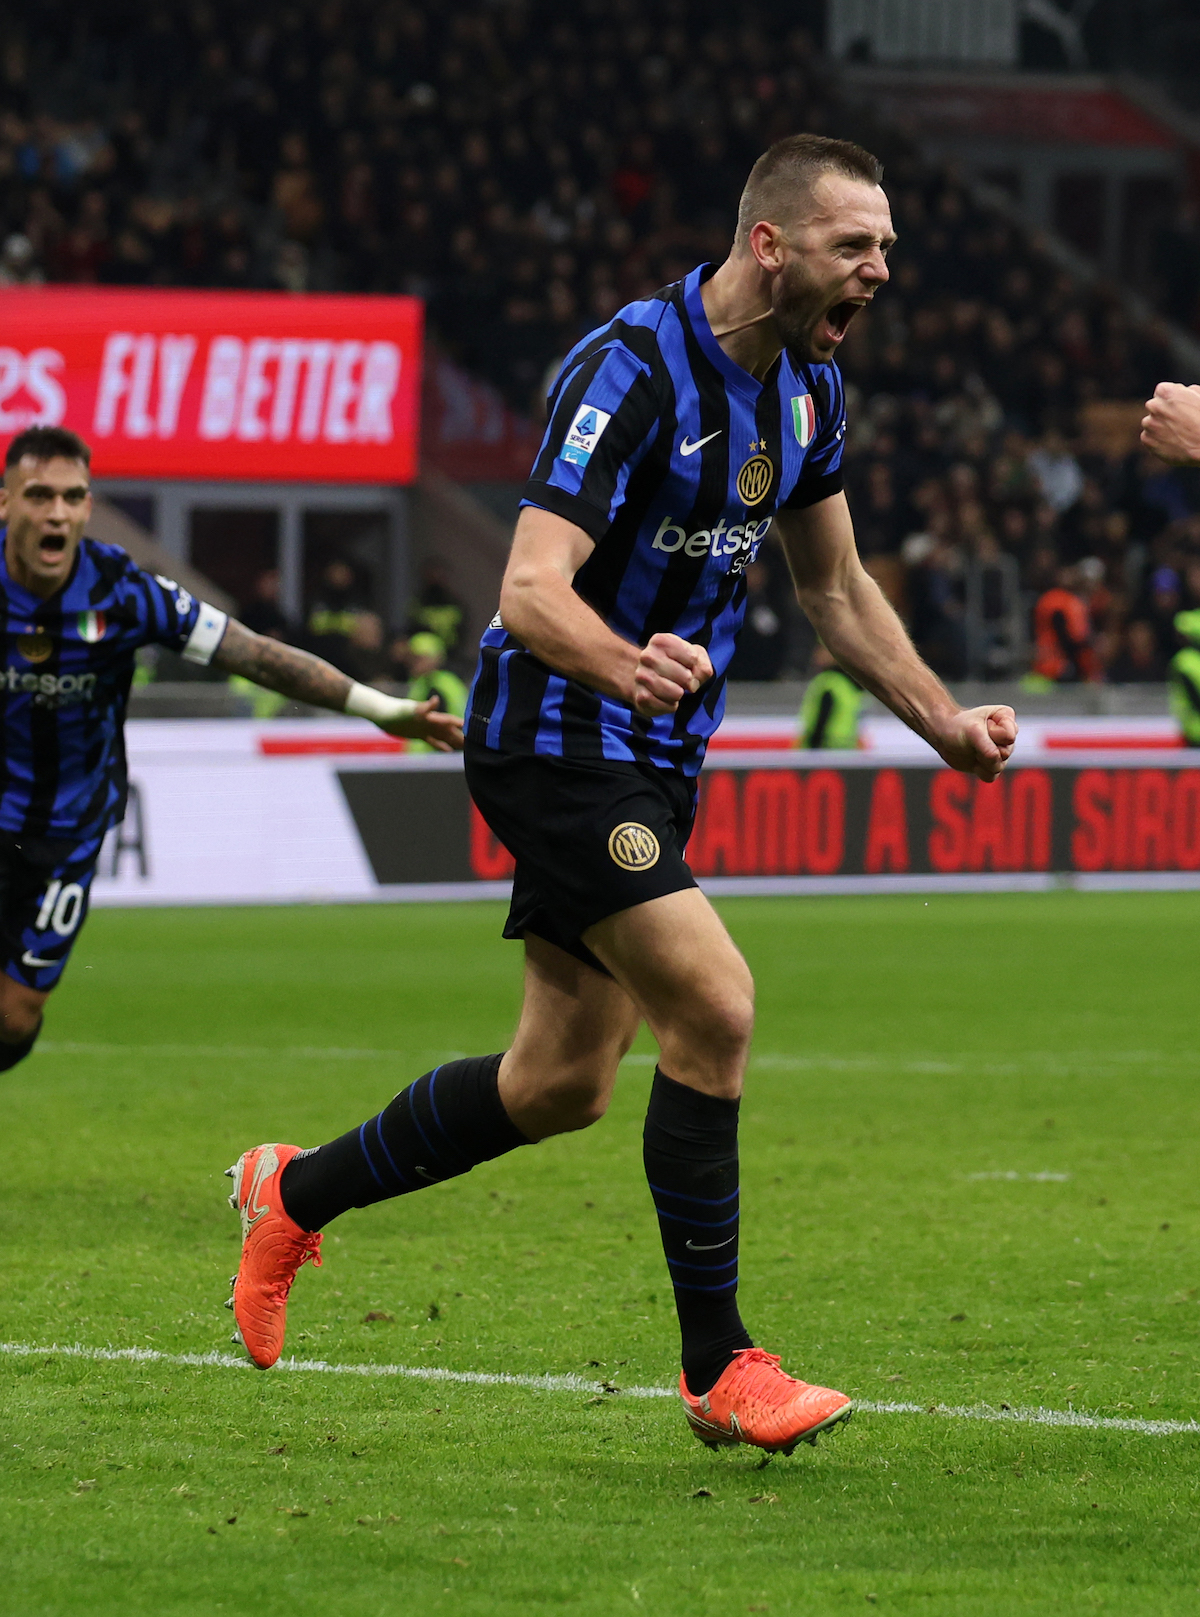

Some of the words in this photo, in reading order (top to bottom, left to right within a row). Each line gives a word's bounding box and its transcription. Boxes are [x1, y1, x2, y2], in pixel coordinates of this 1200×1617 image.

[92, 331, 197, 439] FLY
[199, 334, 402, 445] BETTER
[570, 434, 586, 444] SERIE
[864, 767, 911, 873] A
[927, 767, 1052, 872] SAN
[36, 879, 84, 936] 10
